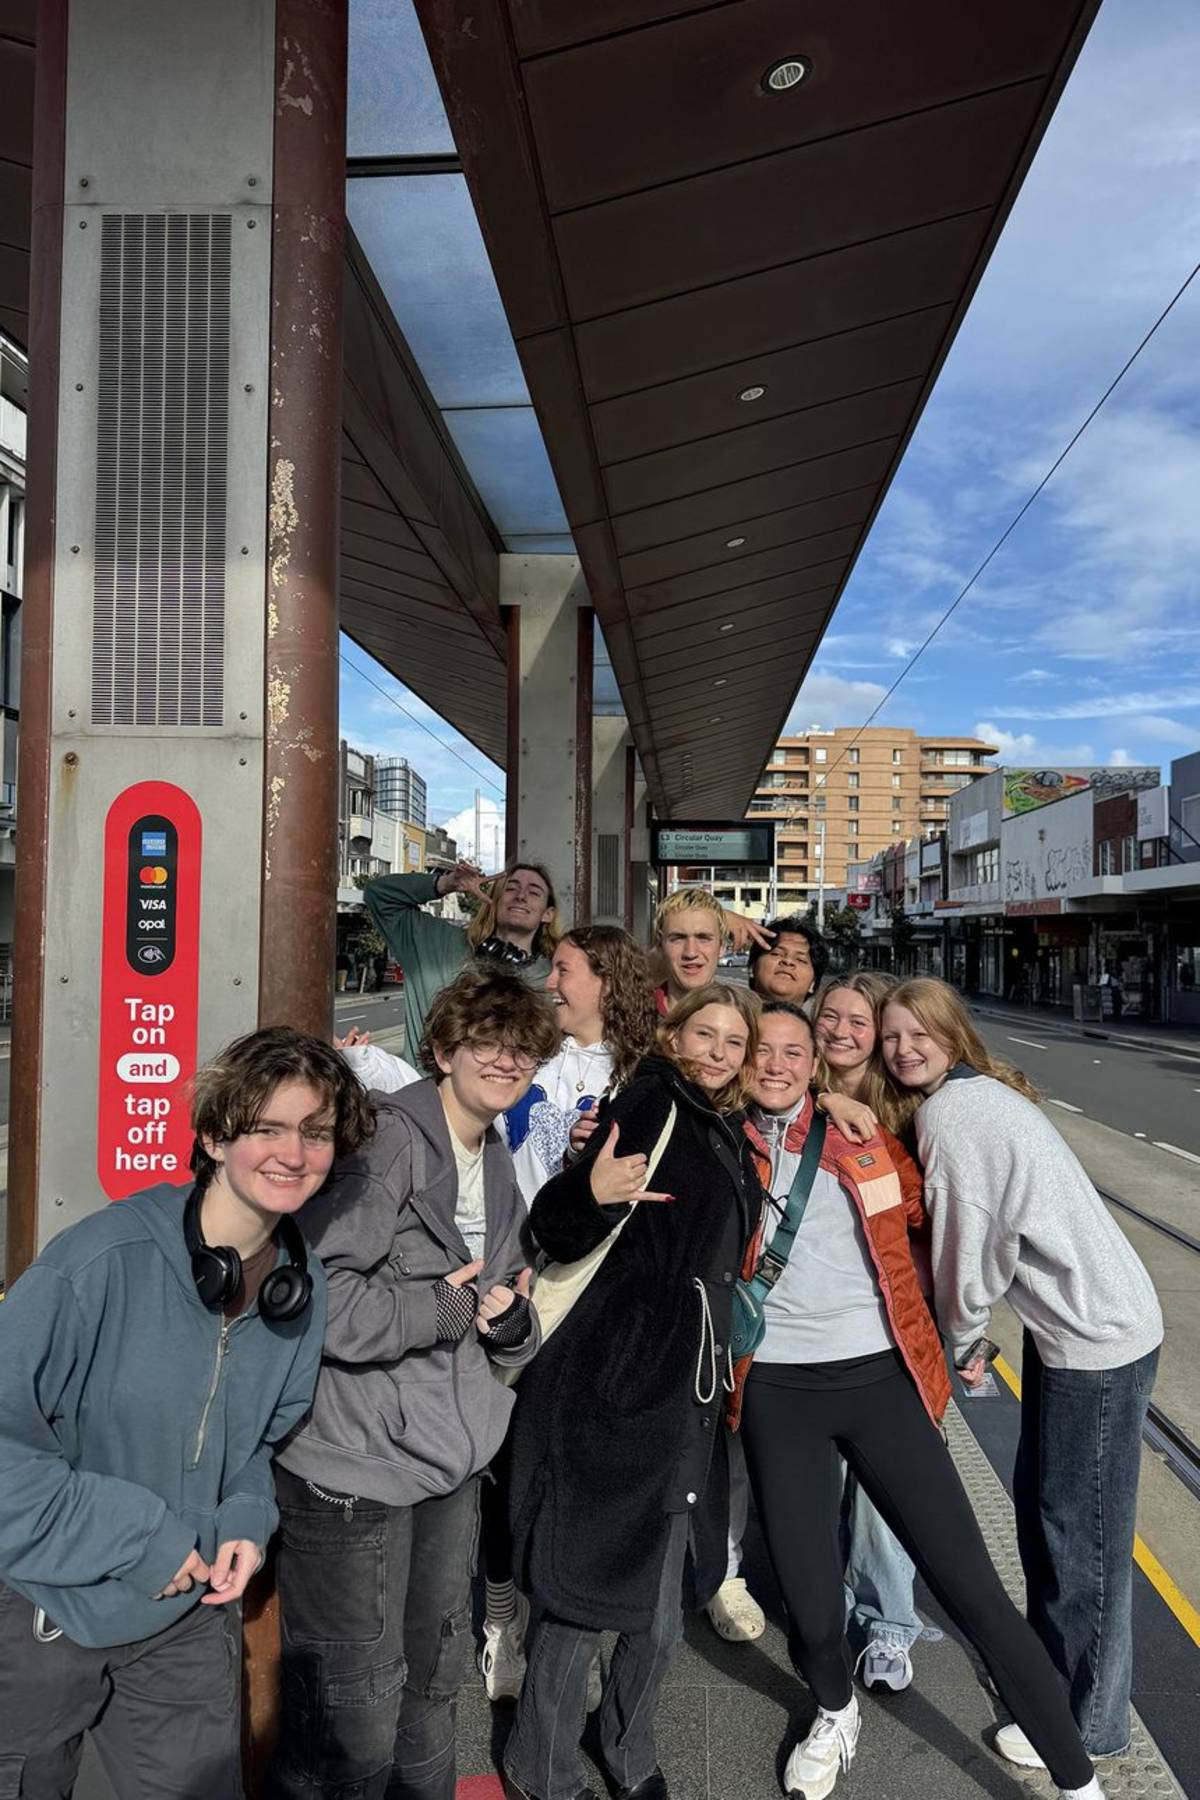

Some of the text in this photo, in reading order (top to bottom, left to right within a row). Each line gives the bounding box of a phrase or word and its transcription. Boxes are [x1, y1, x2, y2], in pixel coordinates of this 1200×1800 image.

[704, 834, 723, 842] Quay
[139, 899, 167, 910] VISA
[138, 919, 165, 931] opal
[124, 998, 176, 1026] Tap
[132, 1026, 166, 1045] on
[129, 1058, 168, 1077] and
[124, 1093, 171, 1119] tap
[127, 1121, 167, 1144] off
[115, 1147, 178, 1171] here
